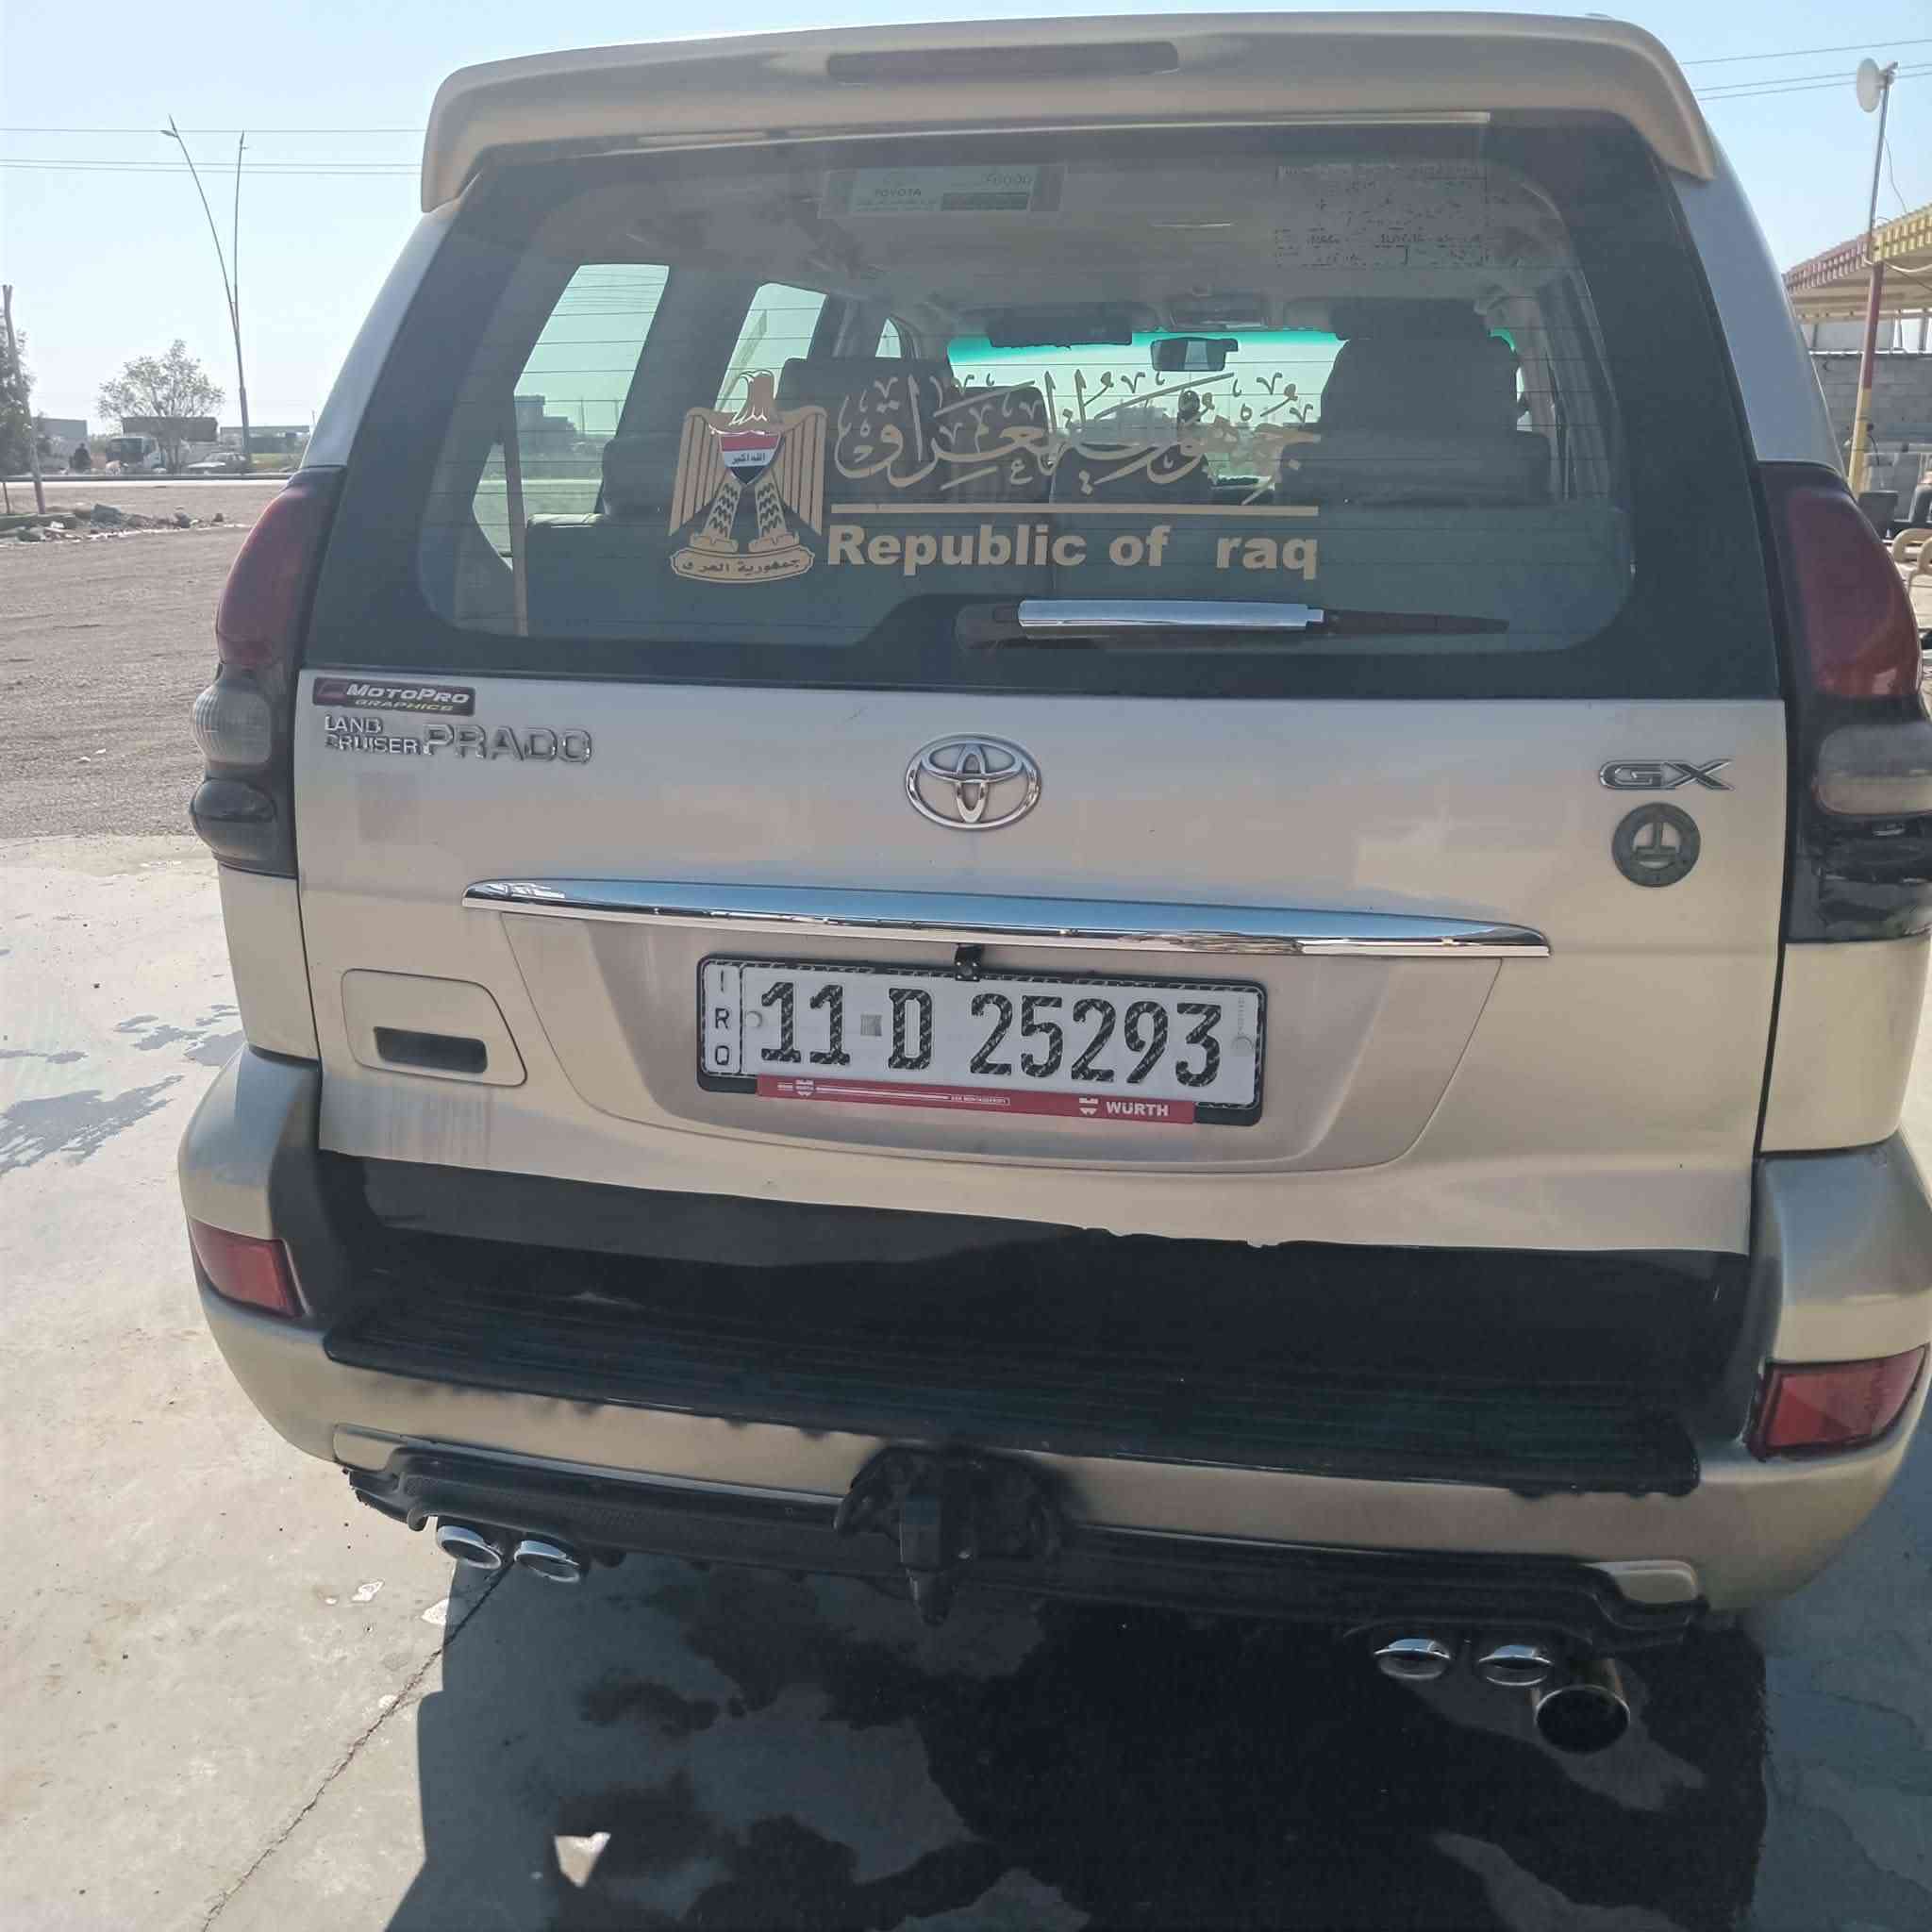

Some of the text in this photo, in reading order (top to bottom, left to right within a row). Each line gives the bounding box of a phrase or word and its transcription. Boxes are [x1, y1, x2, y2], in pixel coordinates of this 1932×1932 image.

[827, 525, 1087, 576] Republic
[1108, 522, 1170, 567] of
[325, 714, 383, 734] LAND
[325, 734, 417, 754] CRUISER
[421, 724, 593, 763] PRADO
[1600, 758, 1736, 791] GX
[760, 981, 851, 1066] 11
[888, 987, 933, 1071] D
[969, 992, 1222, 1088] 25293
